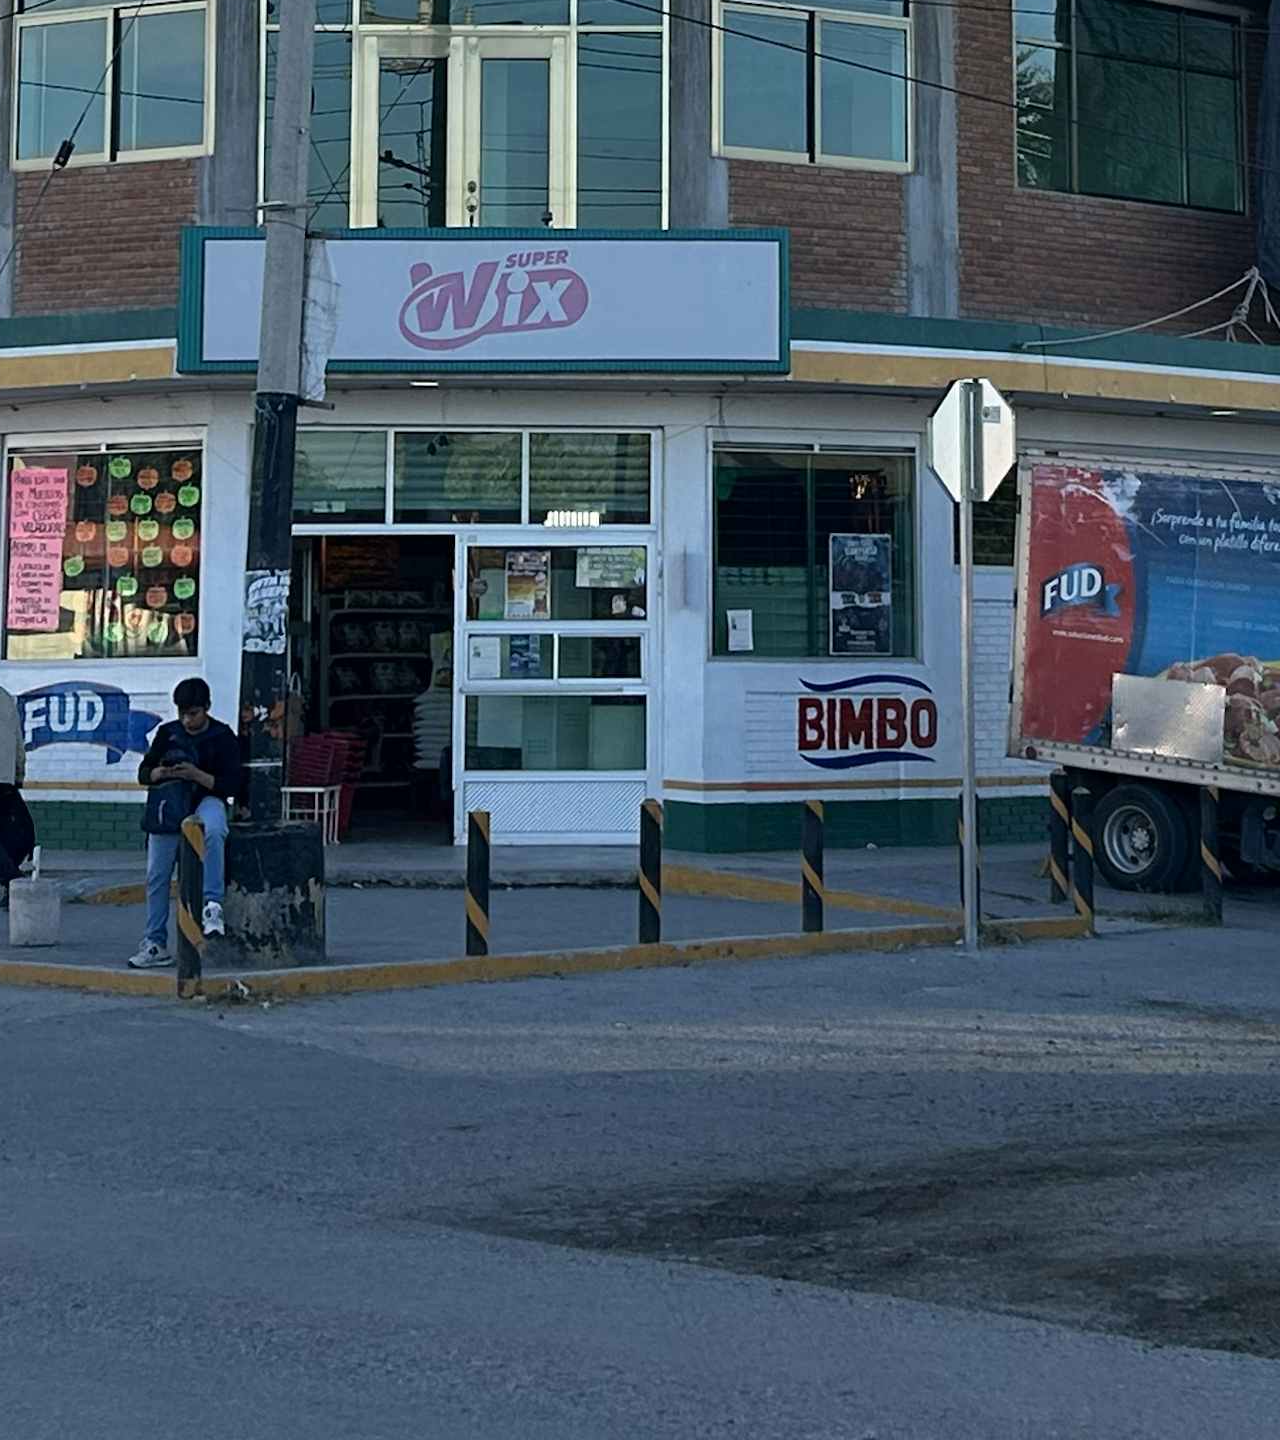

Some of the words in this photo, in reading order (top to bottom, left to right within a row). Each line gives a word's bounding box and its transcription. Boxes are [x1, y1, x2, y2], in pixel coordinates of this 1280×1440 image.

[505, 249, 569, 268] SUPER
[1216, 514, 1226, 528] tu
[1044, 568, 1102, 610] FUD
[23, 690, 105, 745] FUD
[797, 697, 938, 752] BIMBO
